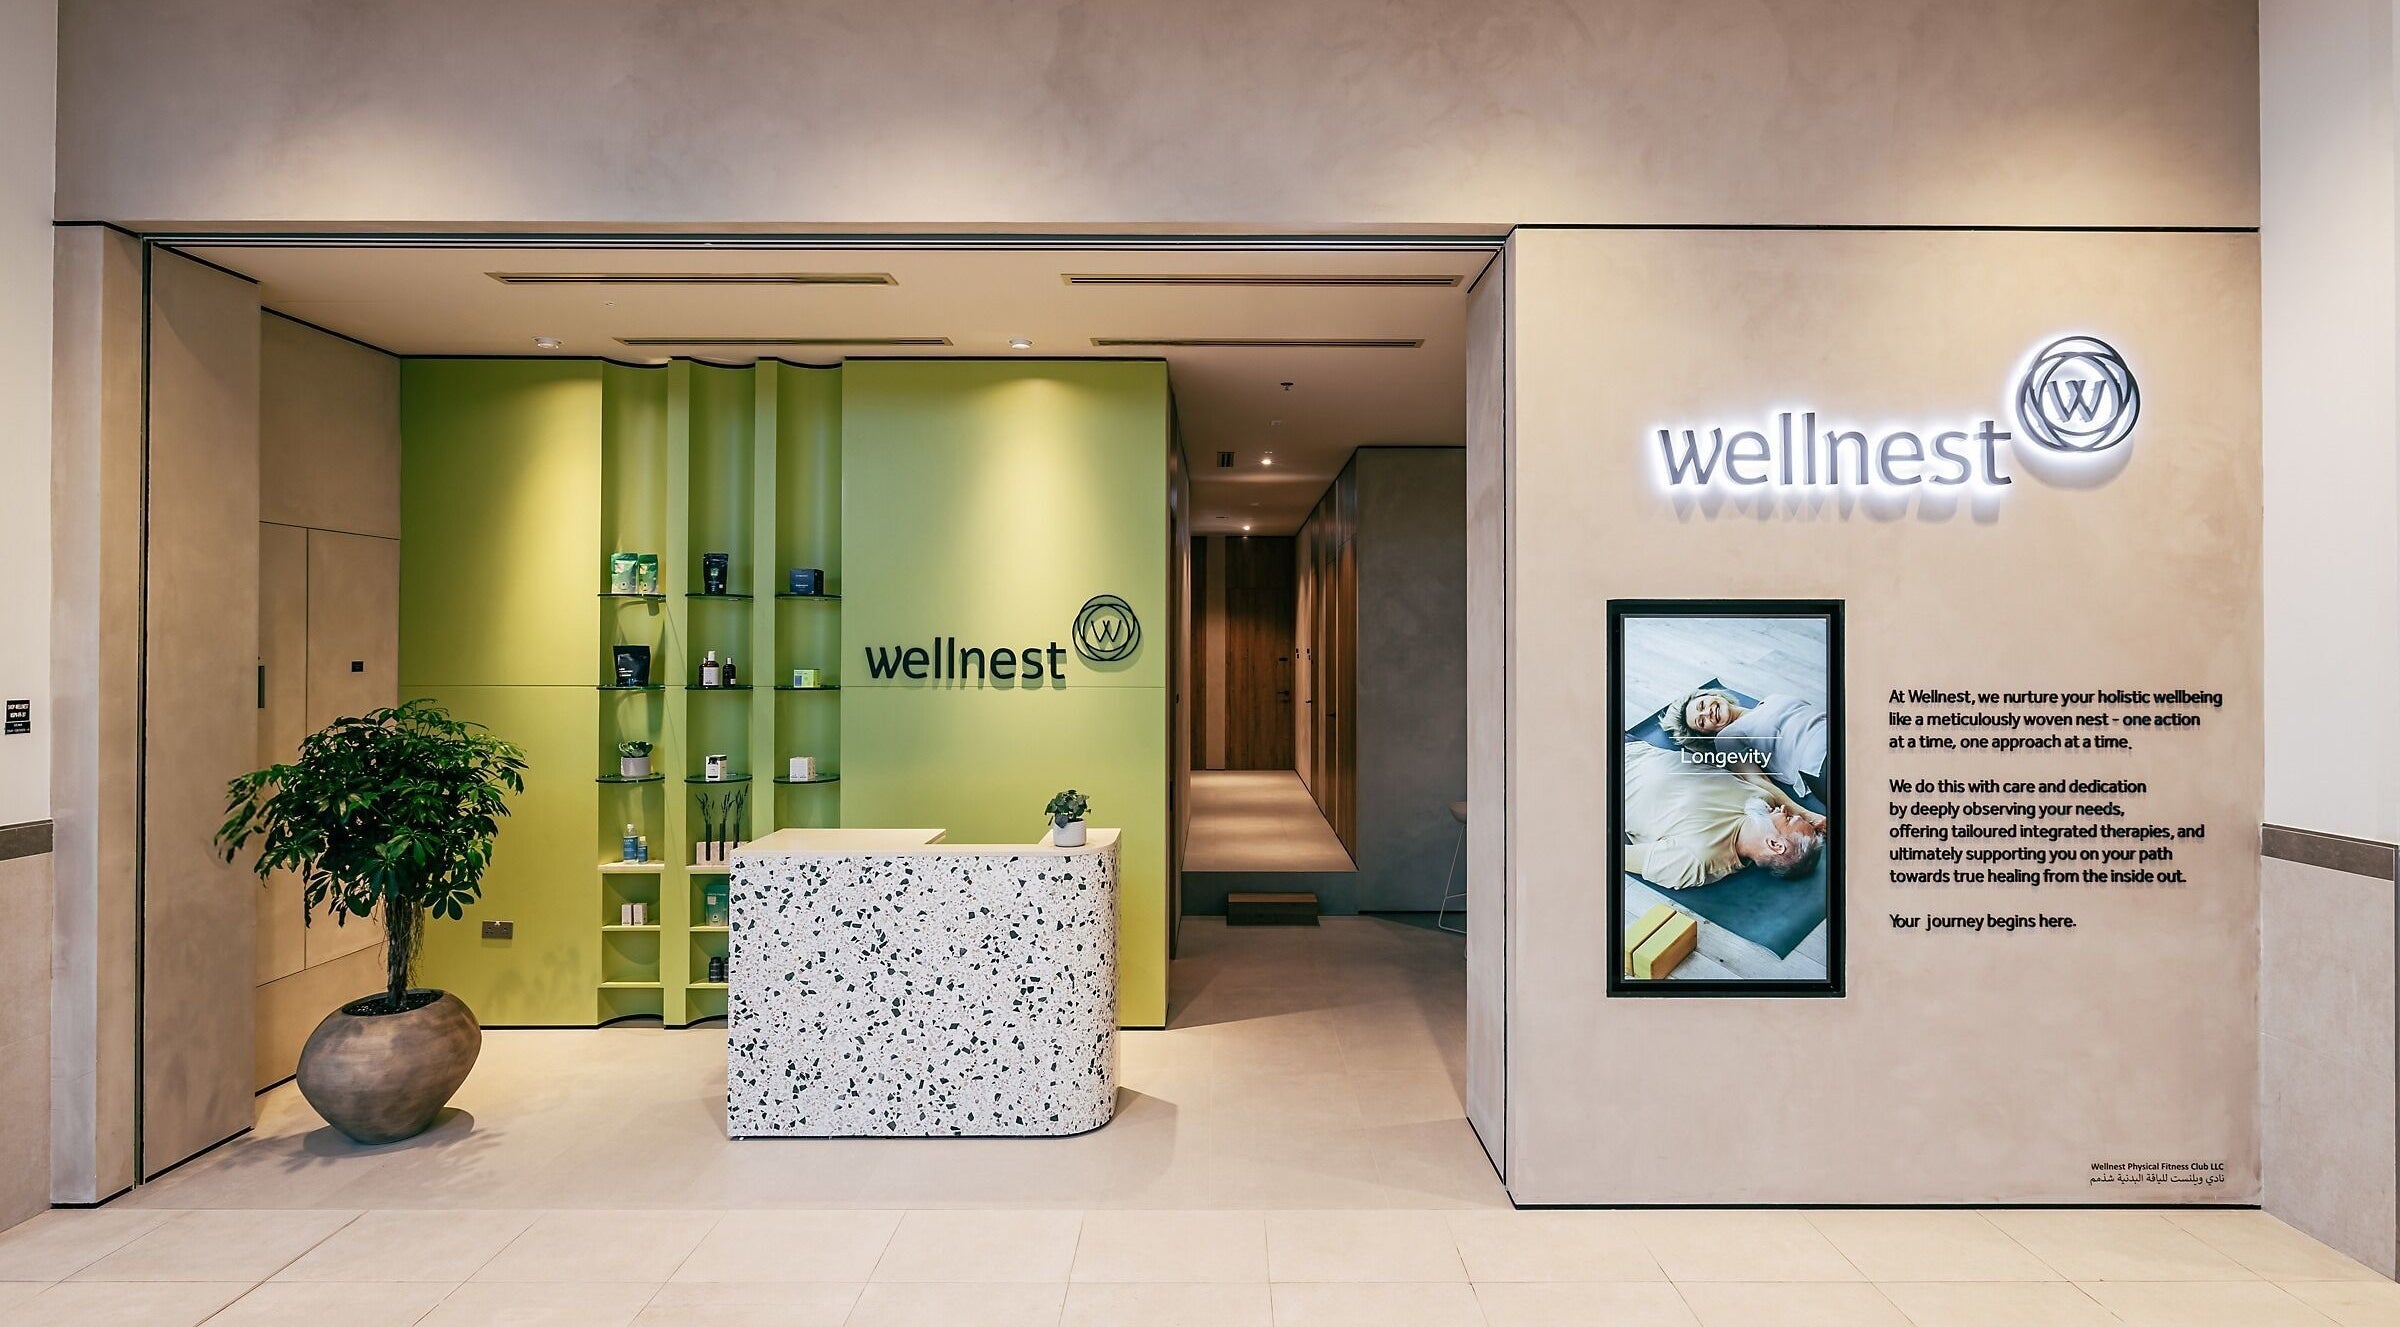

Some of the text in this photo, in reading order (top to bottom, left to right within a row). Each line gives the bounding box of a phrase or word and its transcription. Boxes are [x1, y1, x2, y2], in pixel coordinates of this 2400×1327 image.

[1657, 412, 2012, 485] wellnest
[865, 637, 1067, 680] wellnest
[1888, 689, 2223, 707] At Wellnest, we nurture your holistic wellbeing
[1889, 711, 1913, 725] like
[1914, 715, 1924, 725] a
[1926, 712, 2022, 728] meticulously
[2023, 715, 2073, 725] woven
[2075, 712, 2110, 726] nest
[2122, 715, 2152, 726] one
[2153, 712, 2201, 726] action
[1888, 733, 2133, 751] at a time, one approach at a time.
[1680, 747, 1772, 769] Longevity
[1889, 778, 2147, 793] We do this with care and dedication
[1889, 801, 2125, 817] by deeply observing your needs,
[1889, 823, 2205, 841] offering tailoured integrated therapies, and
[1889, 846, 2173, 864] ultimately supporting you on your path
[1889, 868, 2187, 886] towards true healing from the inside out.
[1889, 913, 2077, 931] Your journey begins here.
[2090, 1162, 2224, 1171] Wellnest Physical Fitness Club LLC
[2117, 1174, 2143, 1184] البدنية
[2145, 1174, 2167, 1184] للياقة
[2170, 1174, 2203, 1185] ويلنست
[2205, 1174, 2224, 1186] نادي
